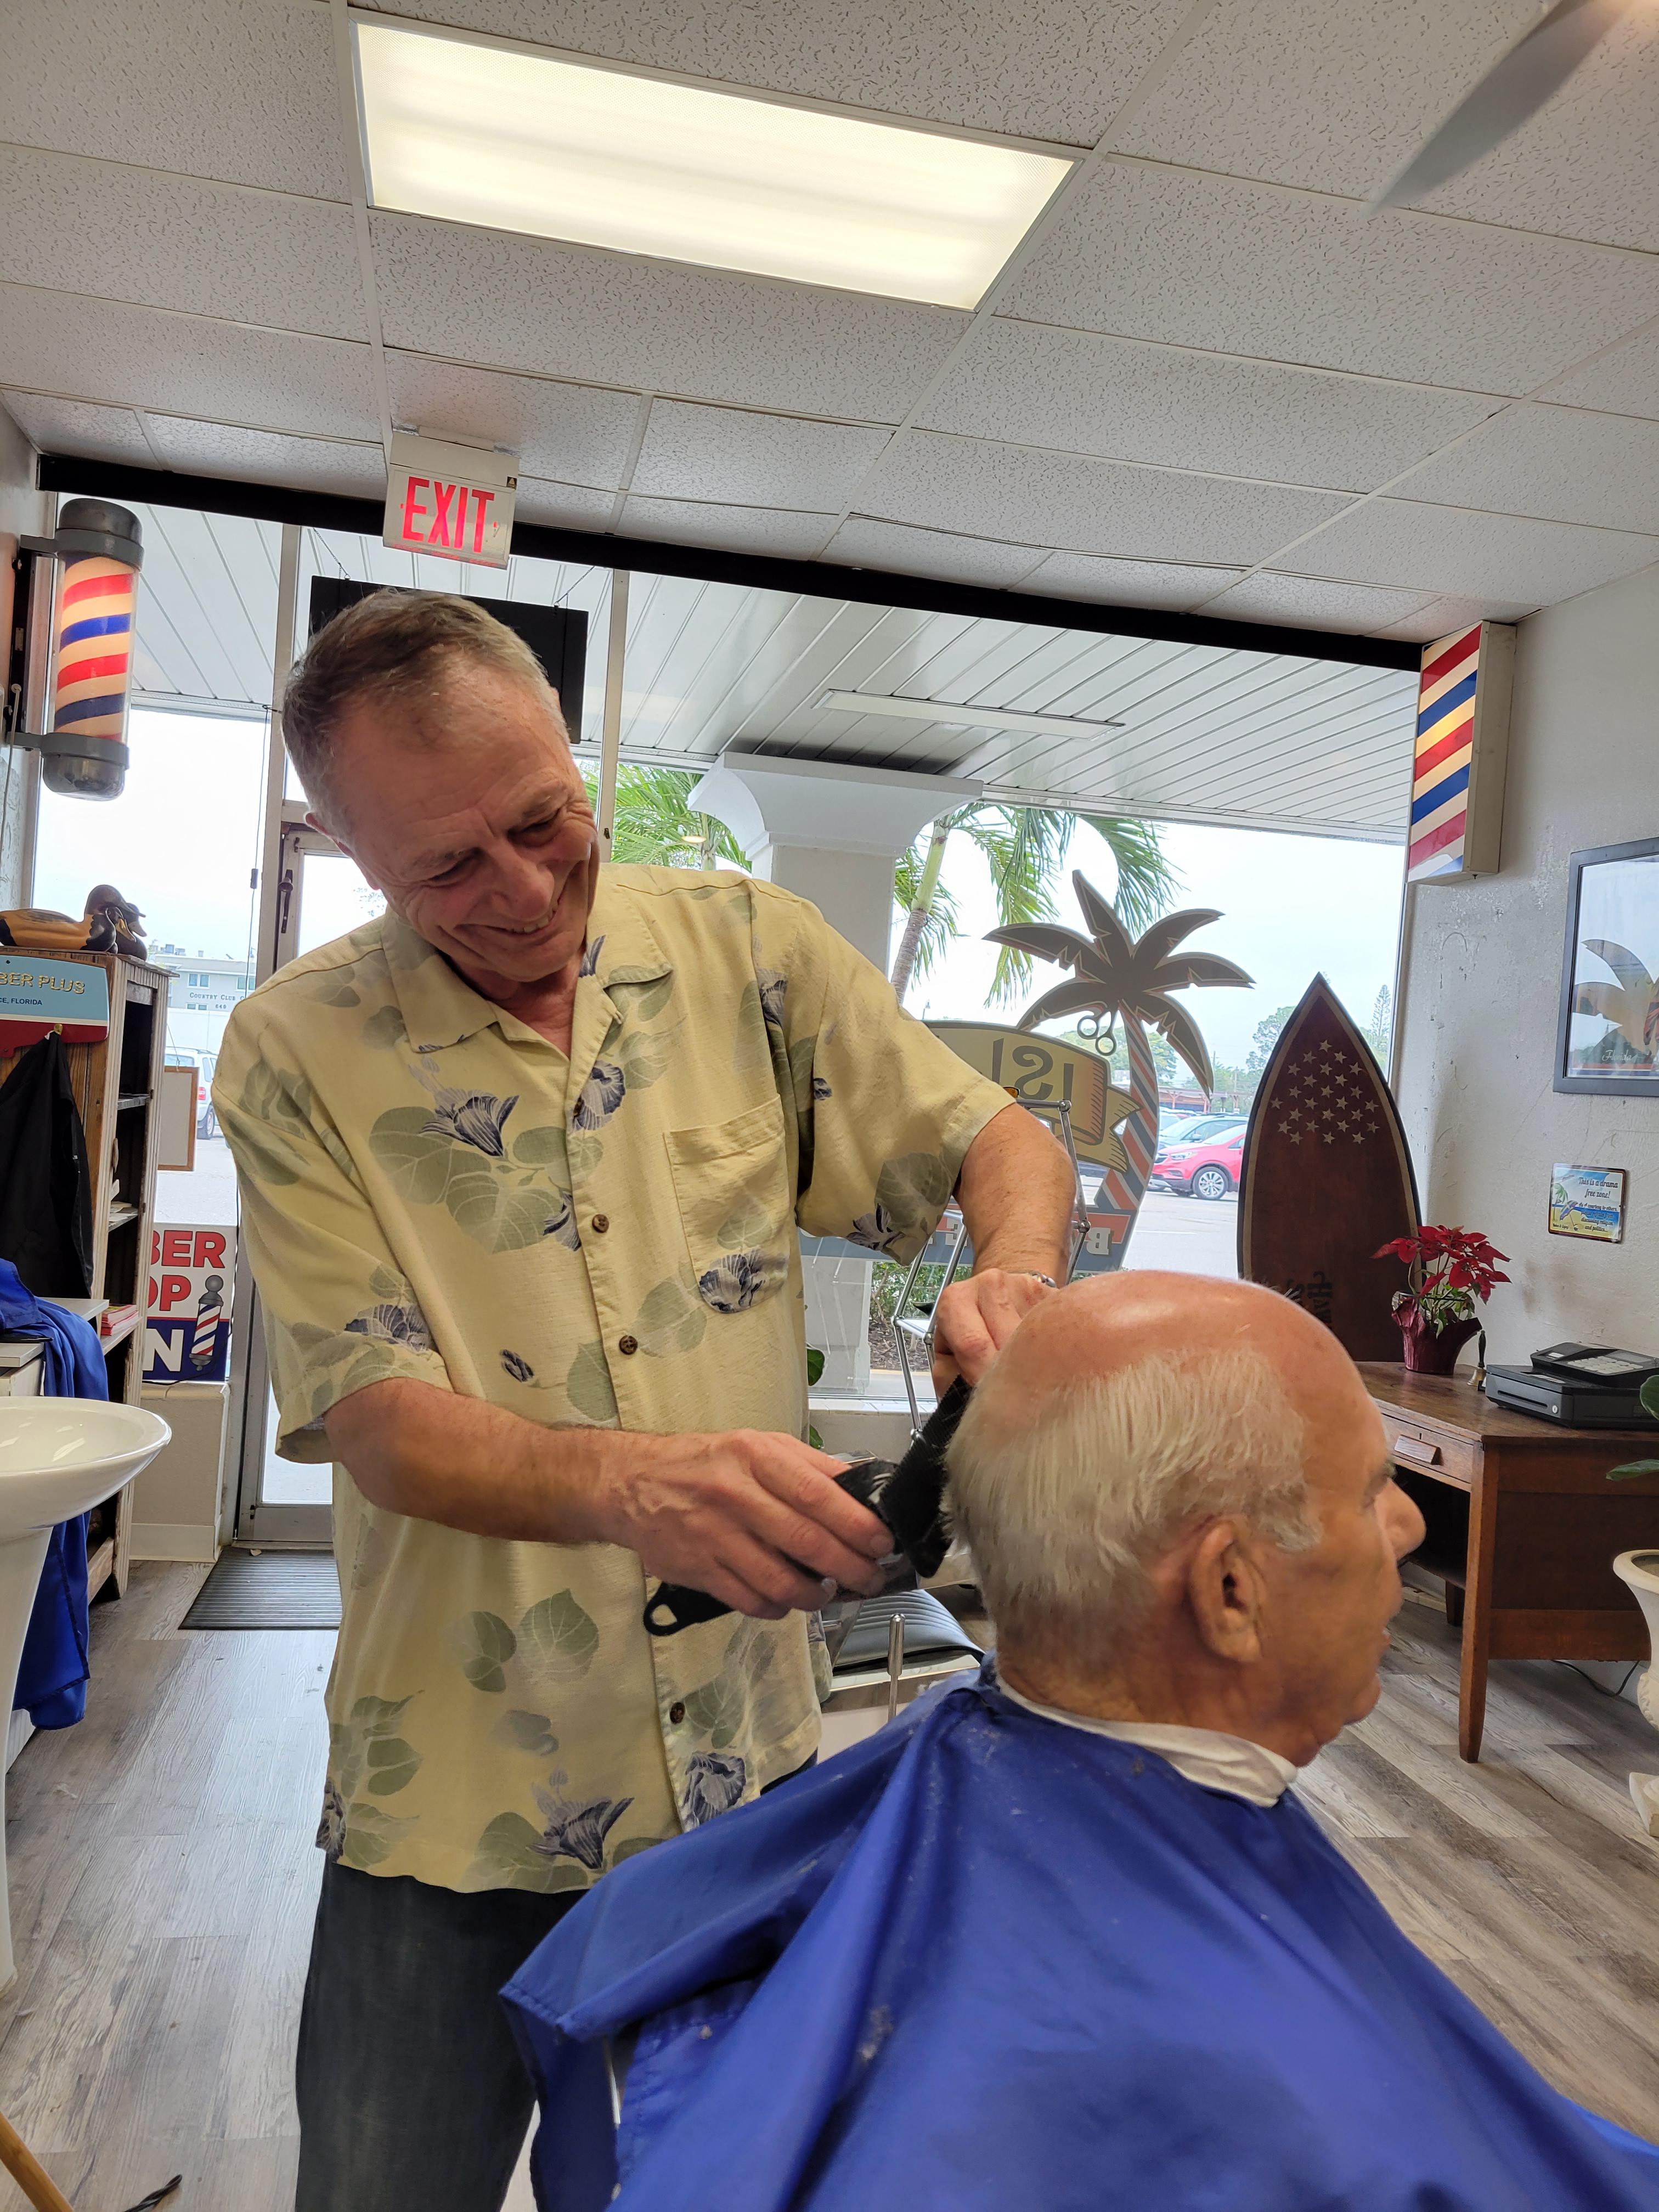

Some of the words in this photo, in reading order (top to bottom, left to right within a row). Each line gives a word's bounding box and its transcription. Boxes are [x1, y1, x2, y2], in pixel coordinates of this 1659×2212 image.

[402, 476, 495, 554] EXIT
[38, 975, 85, 994] PLUS
[1602, 1049, 1632, 1062] Florida
[1578, 1177, 1589, 1185] This
[1600, 1180, 1618, 1188] drama
[1584, 1188, 1596, 1198] free
[1596, 1190, 1611, 1199] zone!
